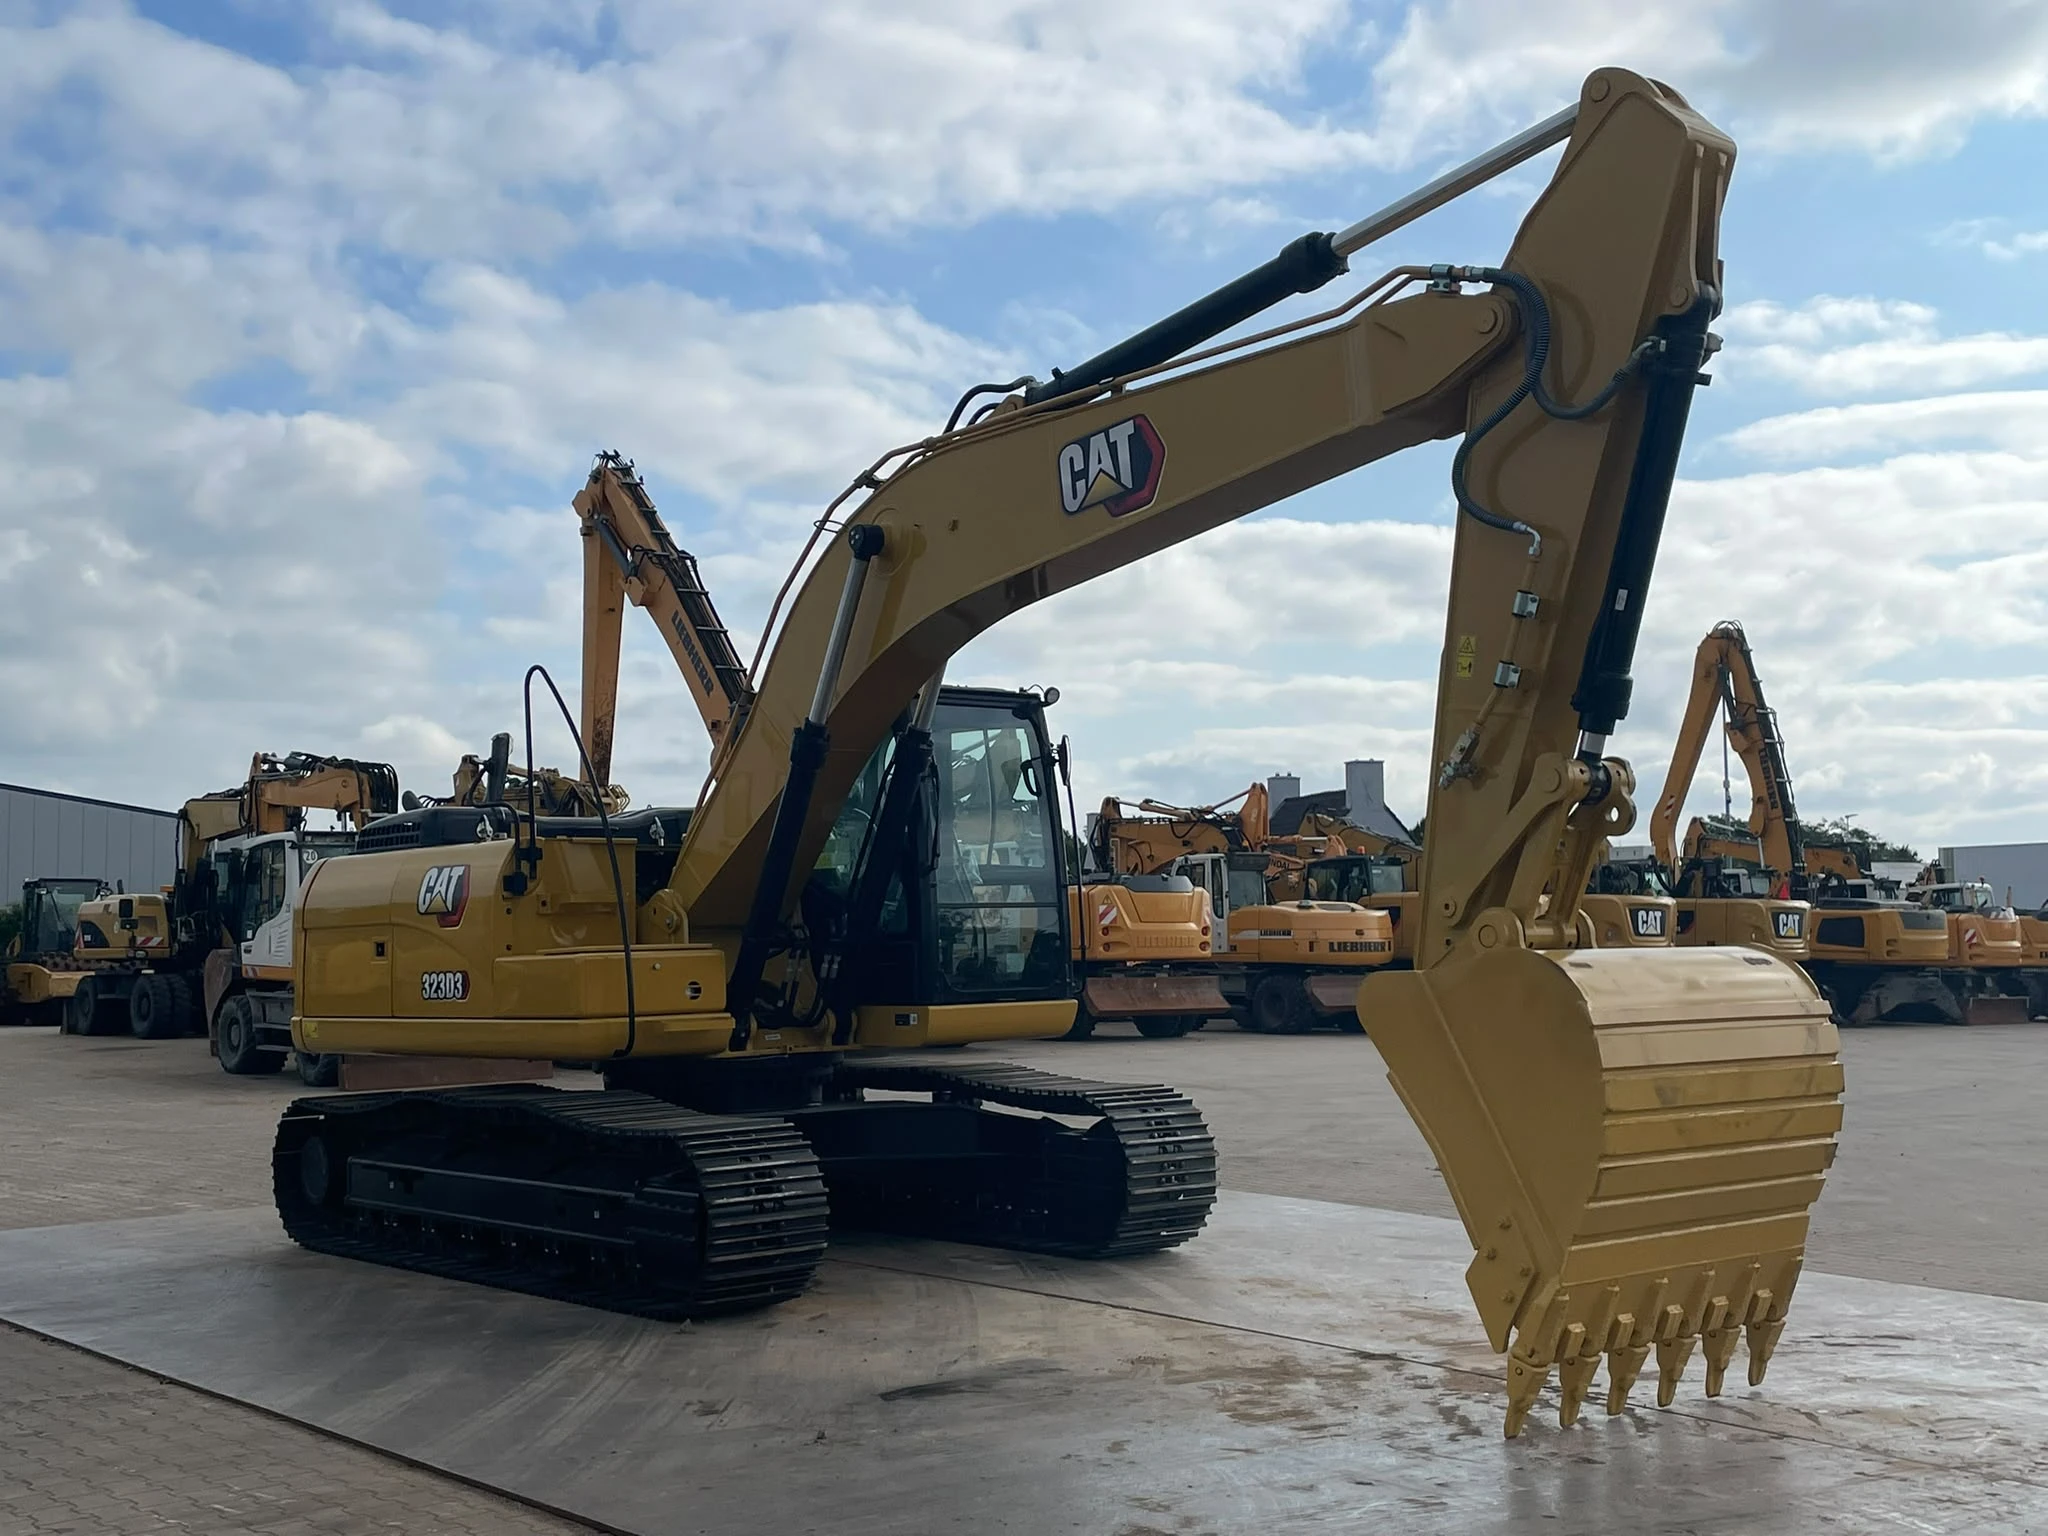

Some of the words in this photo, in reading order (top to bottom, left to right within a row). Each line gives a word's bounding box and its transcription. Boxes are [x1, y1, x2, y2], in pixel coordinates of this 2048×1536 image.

[1059, 419, 1135, 513] CAT
[671, 610, 714, 698] LIEBHERR
[305, 850, 317, 861] 20
[417, 865, 466, 914] CAT
[1637, 910, 1662, 935] CAT
[1778, 913, 1800, 937] CAT
[1328, 941, 1386, 953] LIEBHERR
[421, 971, 463, 1000] 323D3
